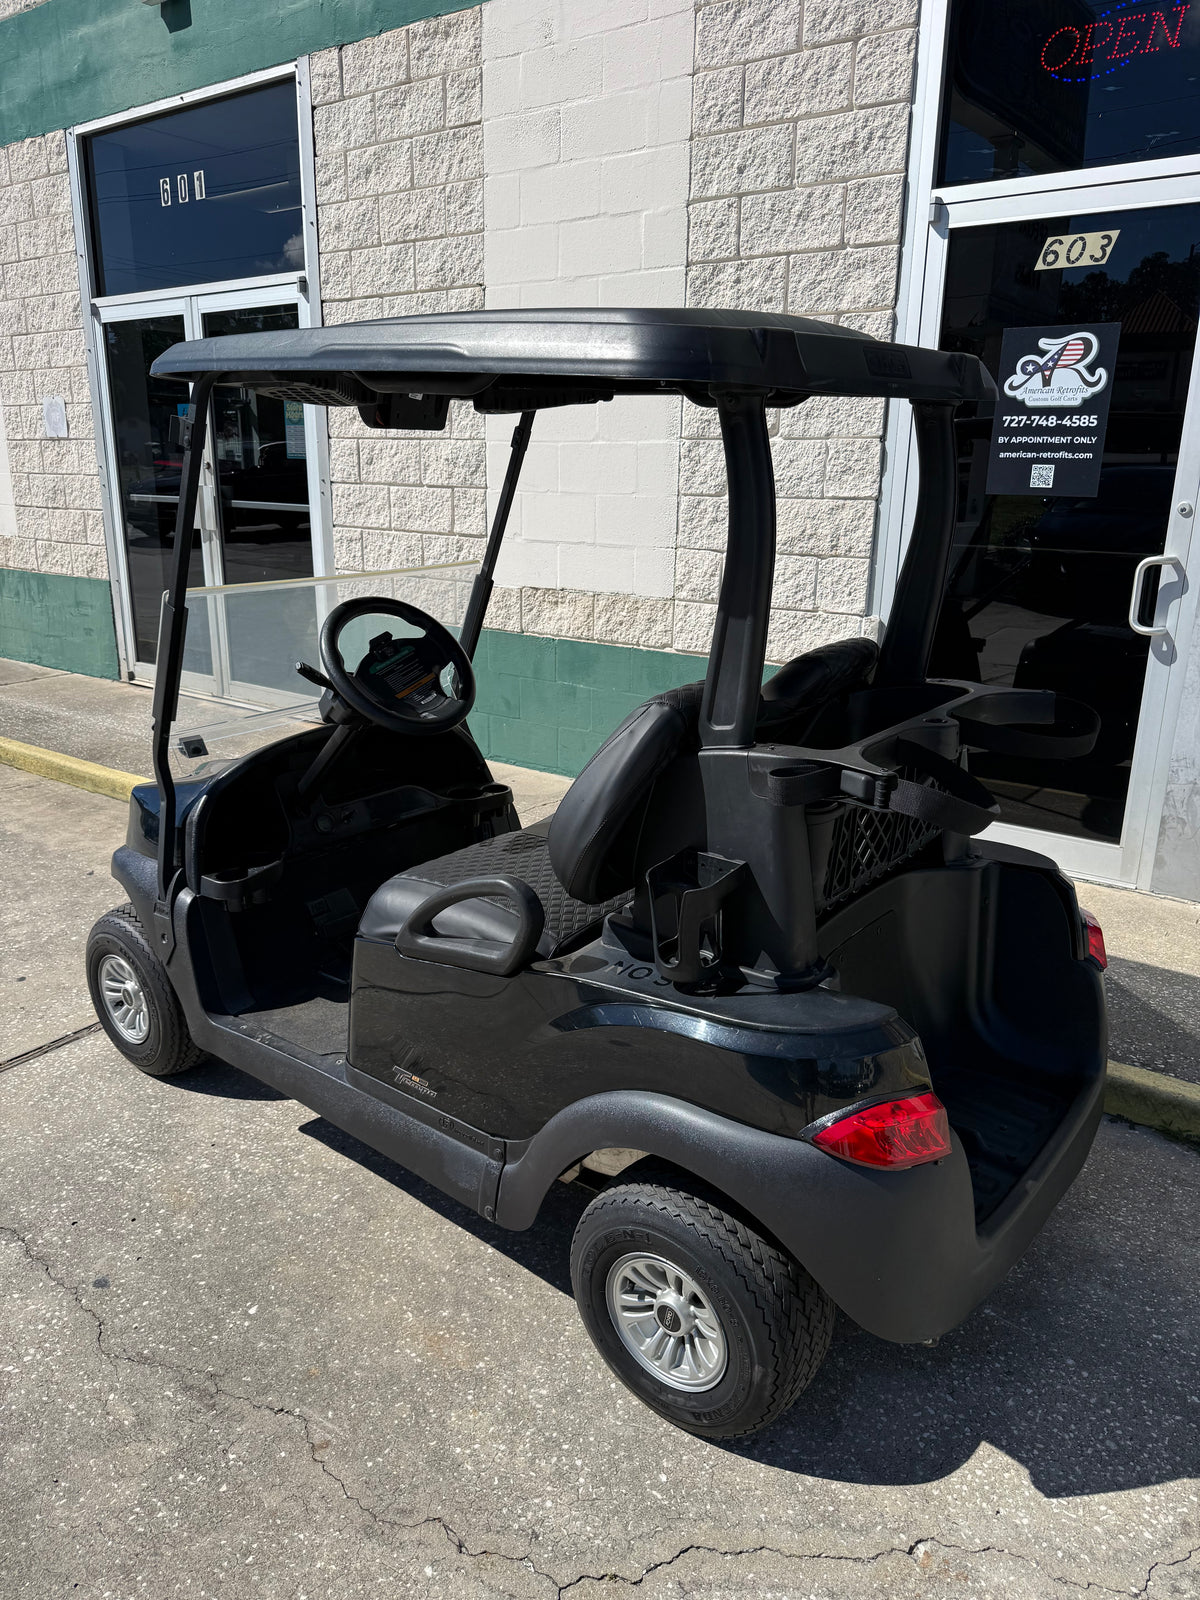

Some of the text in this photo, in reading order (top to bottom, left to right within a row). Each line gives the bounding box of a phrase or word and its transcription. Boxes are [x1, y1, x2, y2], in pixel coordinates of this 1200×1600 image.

[1041, 5, 1190, 71] OPEN
[161, 171, 204, 206] 601
[1041, 234, 1113, 267] 603
[1021, 385, 1089, 396] American Retrofits
[1002, 415, 1098, 427] 727-748-4585
[998, 436, 1098, 444] BY APPOINTMENT ONLY
[999, 450, 1093, 459] american-retrofits.com
